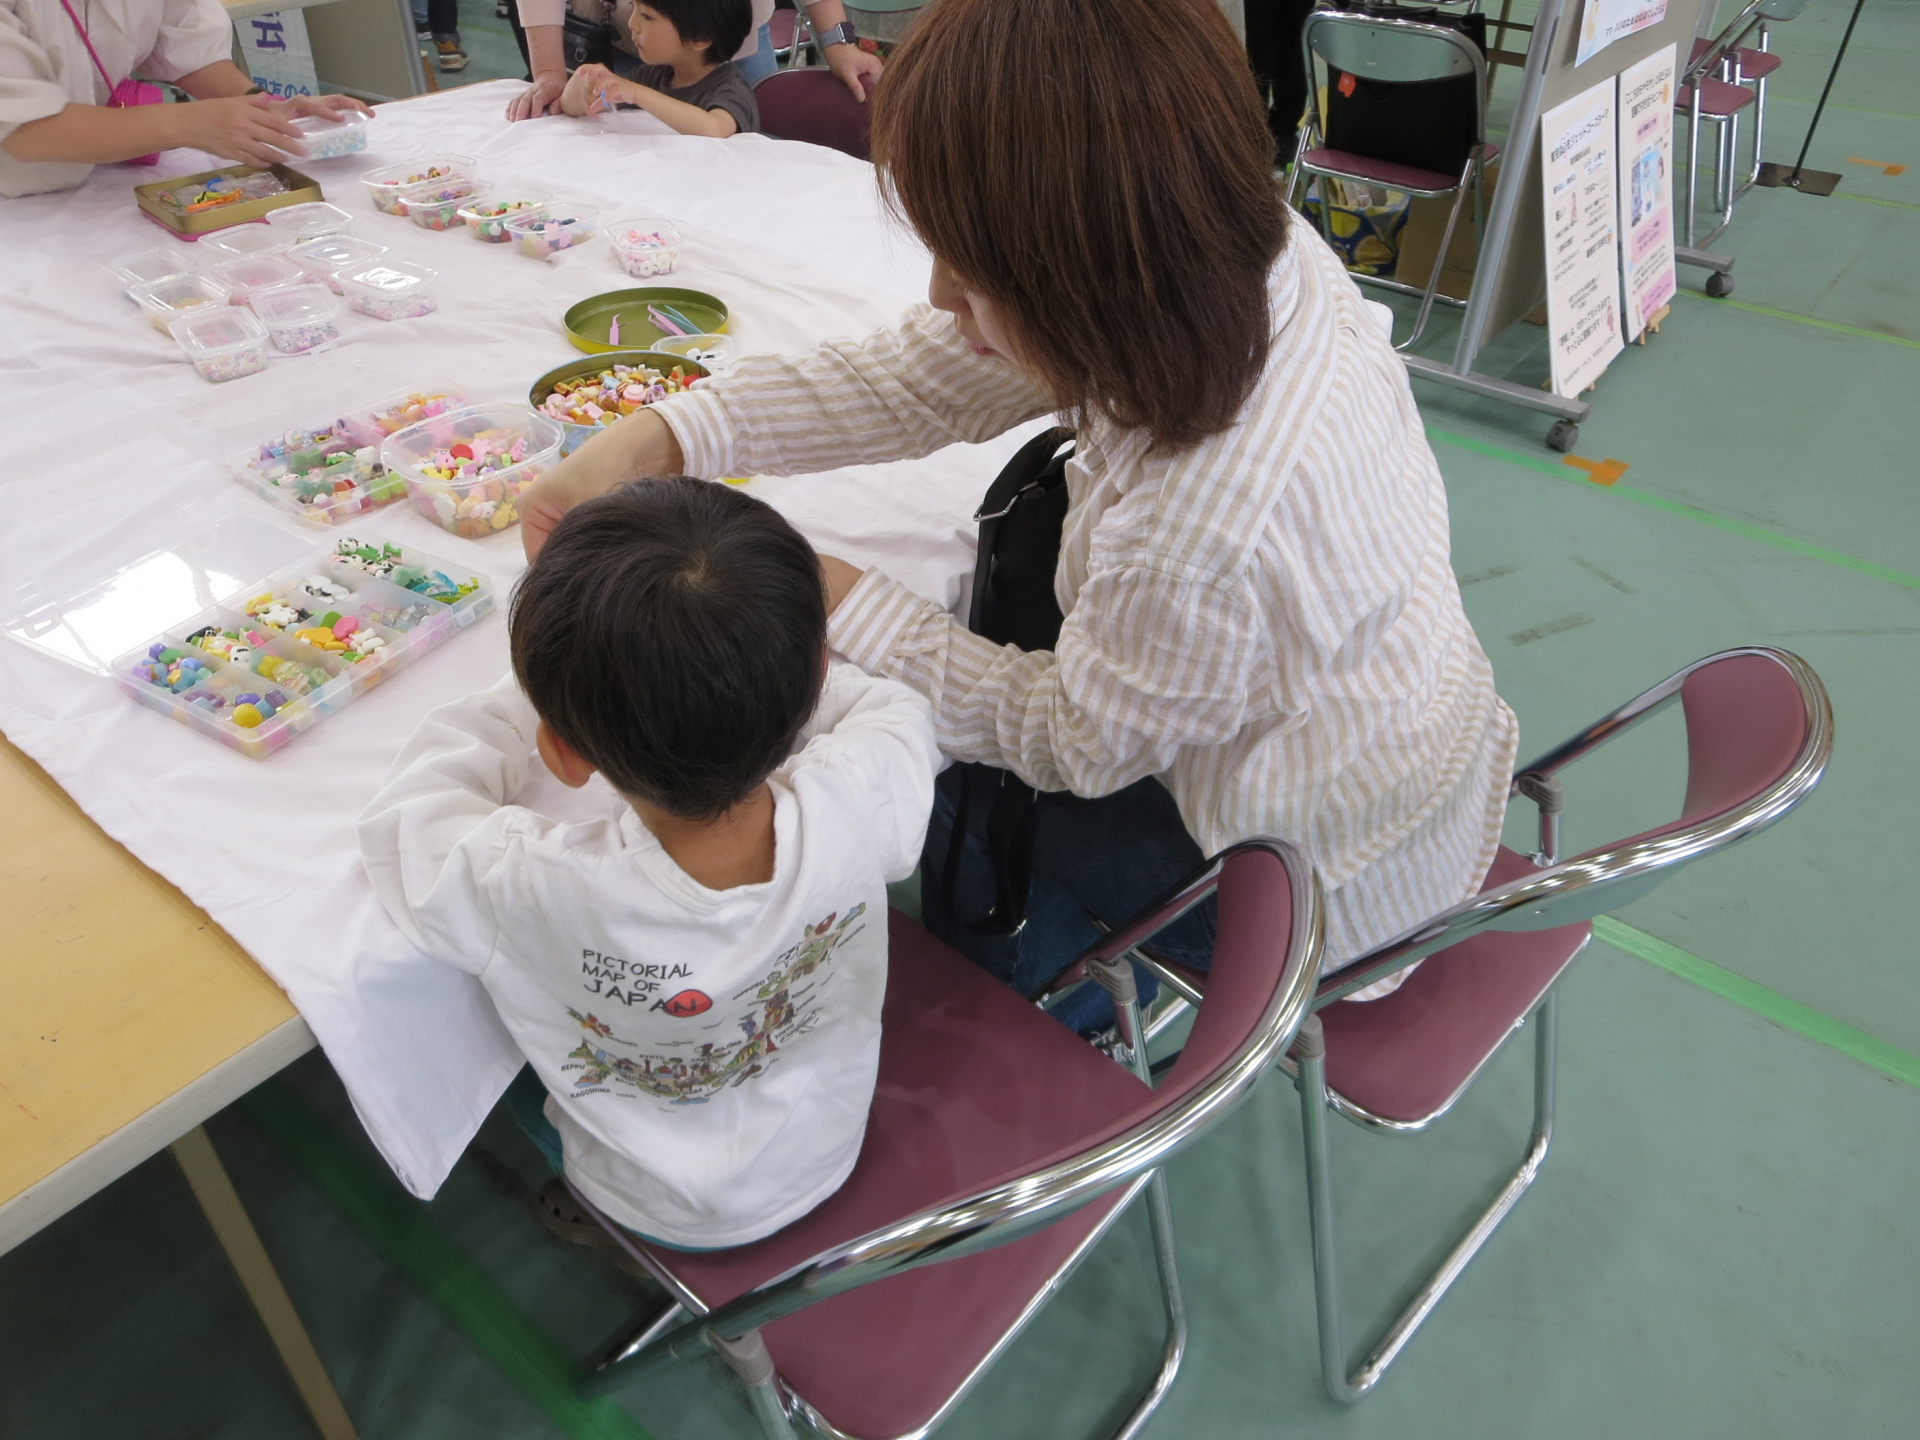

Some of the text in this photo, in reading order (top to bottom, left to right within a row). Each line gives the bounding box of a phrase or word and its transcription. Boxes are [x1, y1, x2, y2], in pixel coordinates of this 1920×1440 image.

[582, 948, 694, 980] PICTORIAL
[582, 961, 661, 993] MAP OF
[583, 978, 697, 1014] JAPAN
[774, 1022, 795, 1040] TOKYO
[560, 1063, 586, 1072] BEPPU
[569, 1087, 612, 1099] KAGOSHIMA
